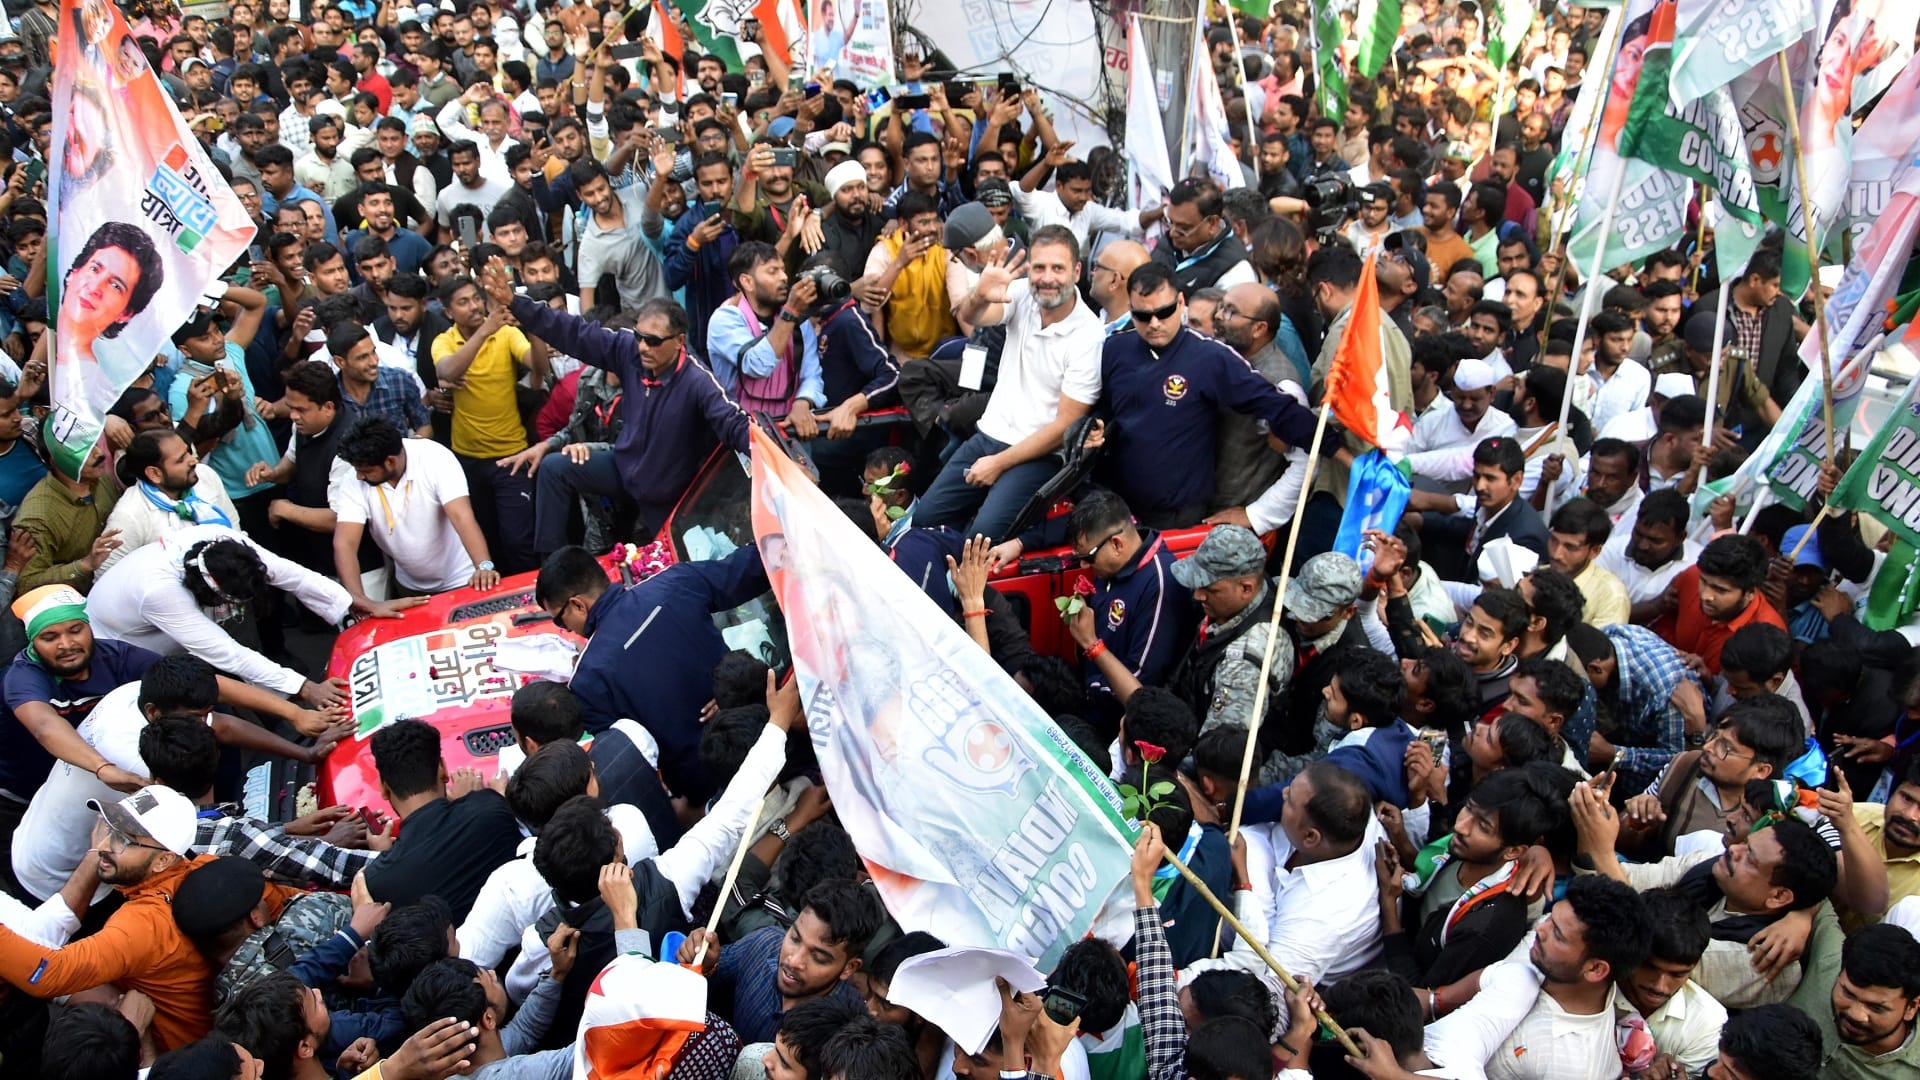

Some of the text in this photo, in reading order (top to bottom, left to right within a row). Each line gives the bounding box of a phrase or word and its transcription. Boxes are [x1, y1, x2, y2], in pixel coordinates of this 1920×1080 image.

[1679, 131, 1752, 209] COGR
[141, 189, 184, 236] यात्रा
[150, 164, 218, 237] न्याय
[352, 650, 384, 709] यात्रा
[428, 650, 477, 703] जोड़ो
[1083, 764, 1116, 803] PRINTERS
